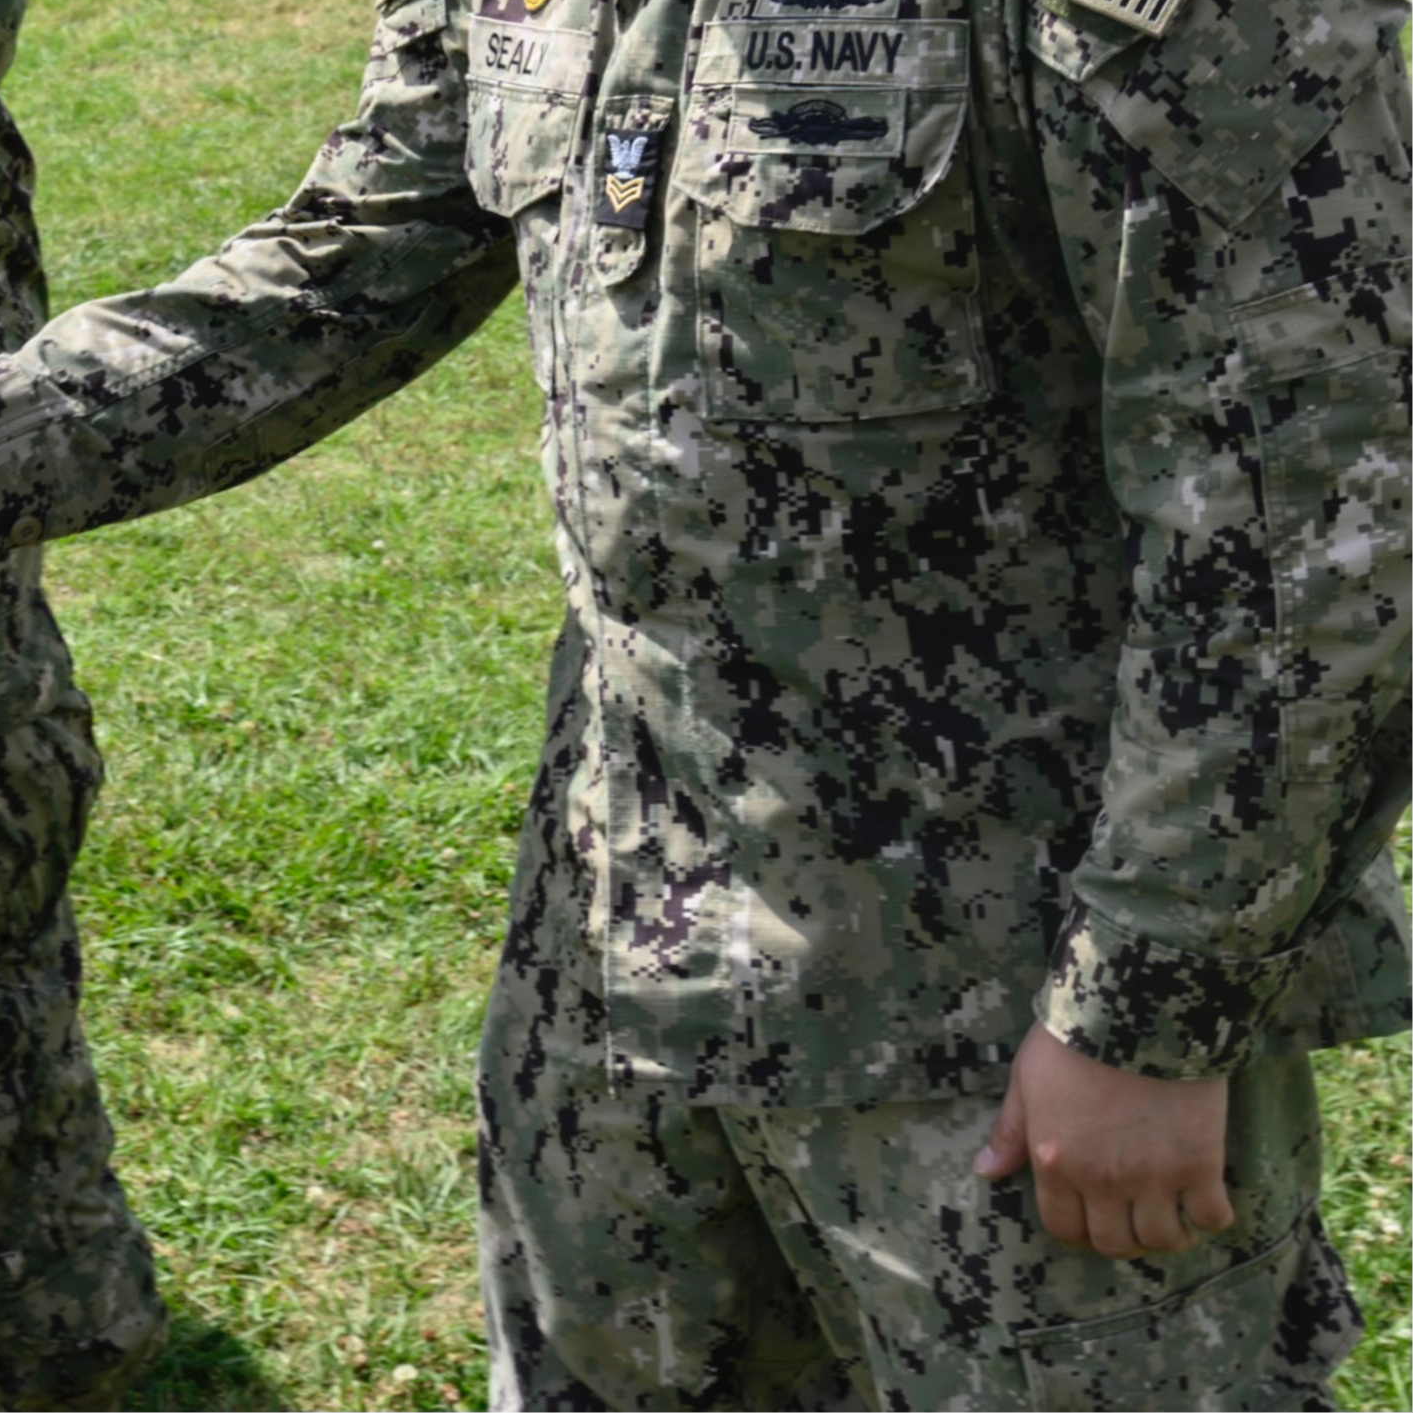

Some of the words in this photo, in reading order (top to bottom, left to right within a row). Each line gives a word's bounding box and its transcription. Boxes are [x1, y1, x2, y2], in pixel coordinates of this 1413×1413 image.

[485, 32, 550, 77] SEALY
[746, 31, 802, 70] U.S.
[810, 30, 903, 74] NAVY
